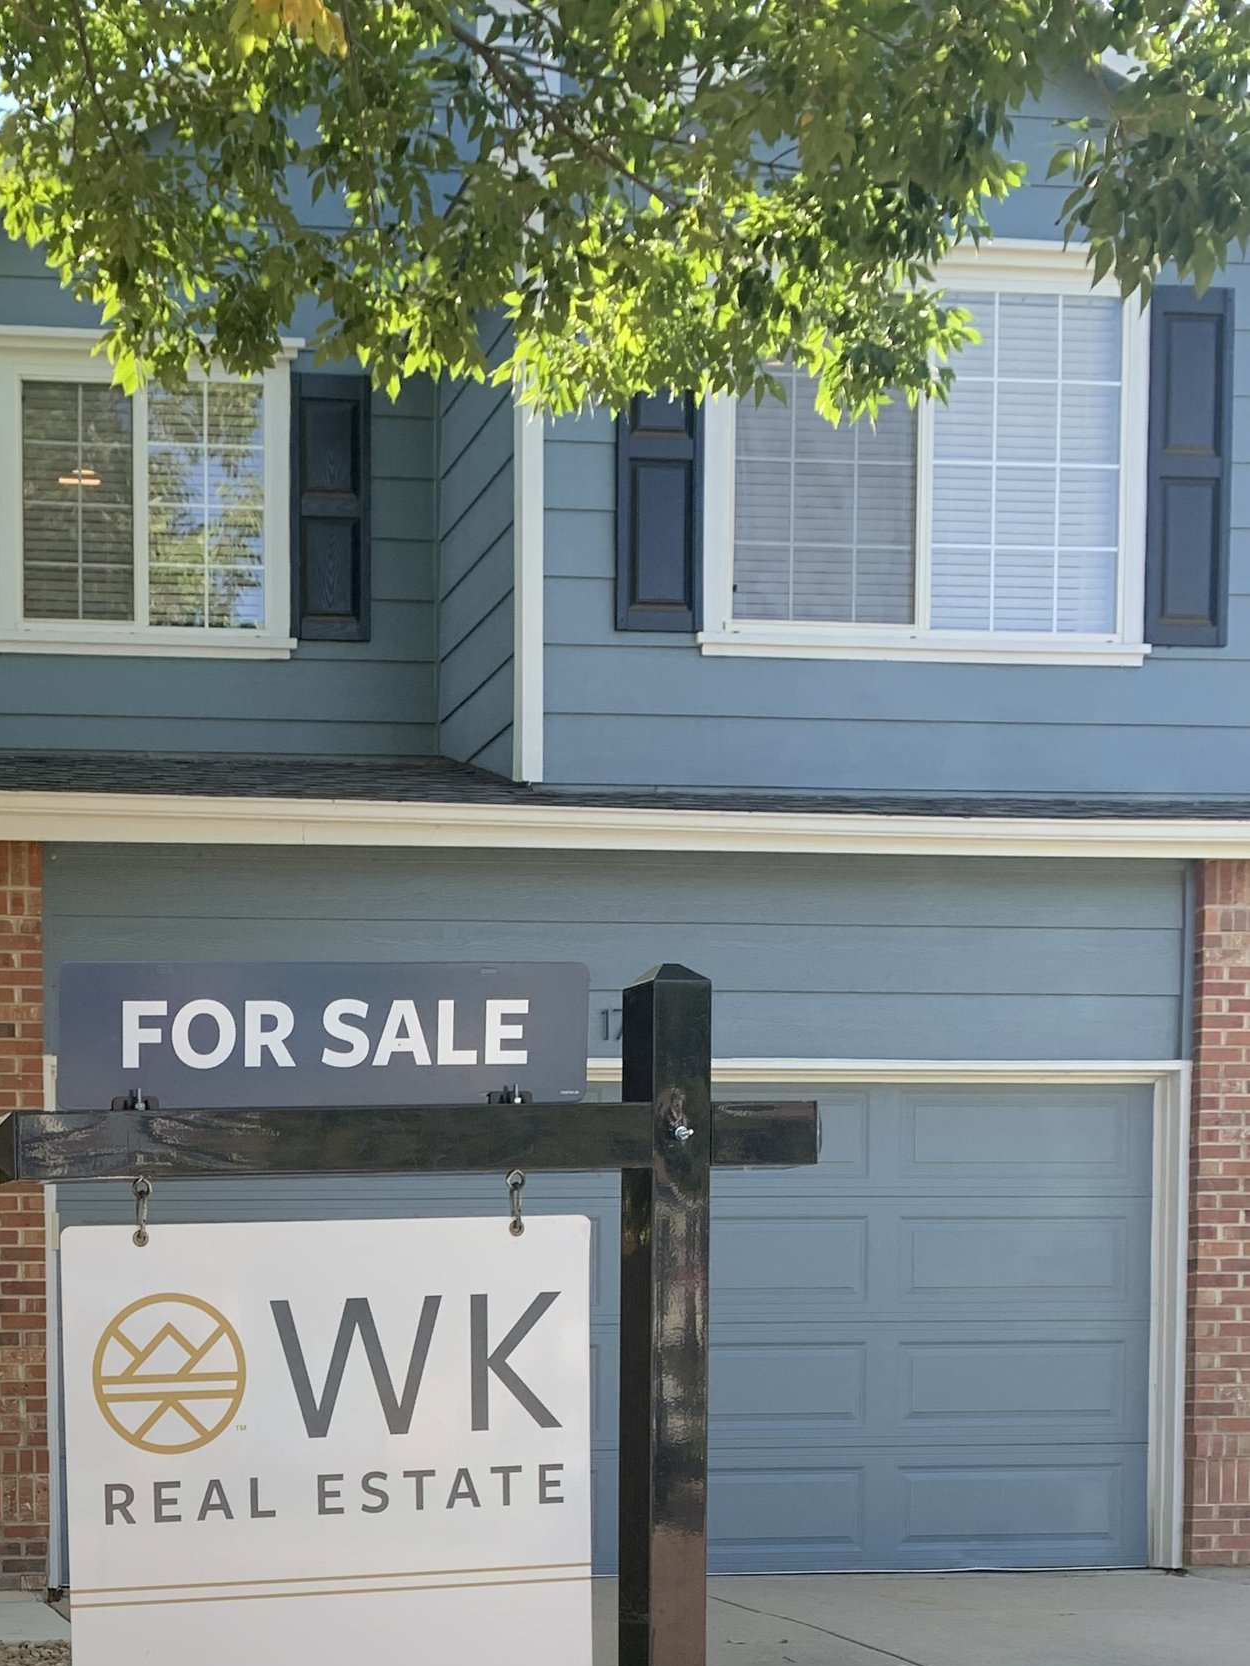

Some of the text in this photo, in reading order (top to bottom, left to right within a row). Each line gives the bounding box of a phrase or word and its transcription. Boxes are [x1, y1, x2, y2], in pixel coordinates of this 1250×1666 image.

[122, 998, 530, 1070] FOR SALE
[269, 1290, 563, 1439] WK
[104, 1463, 565, 1526] REAL ESTATE
